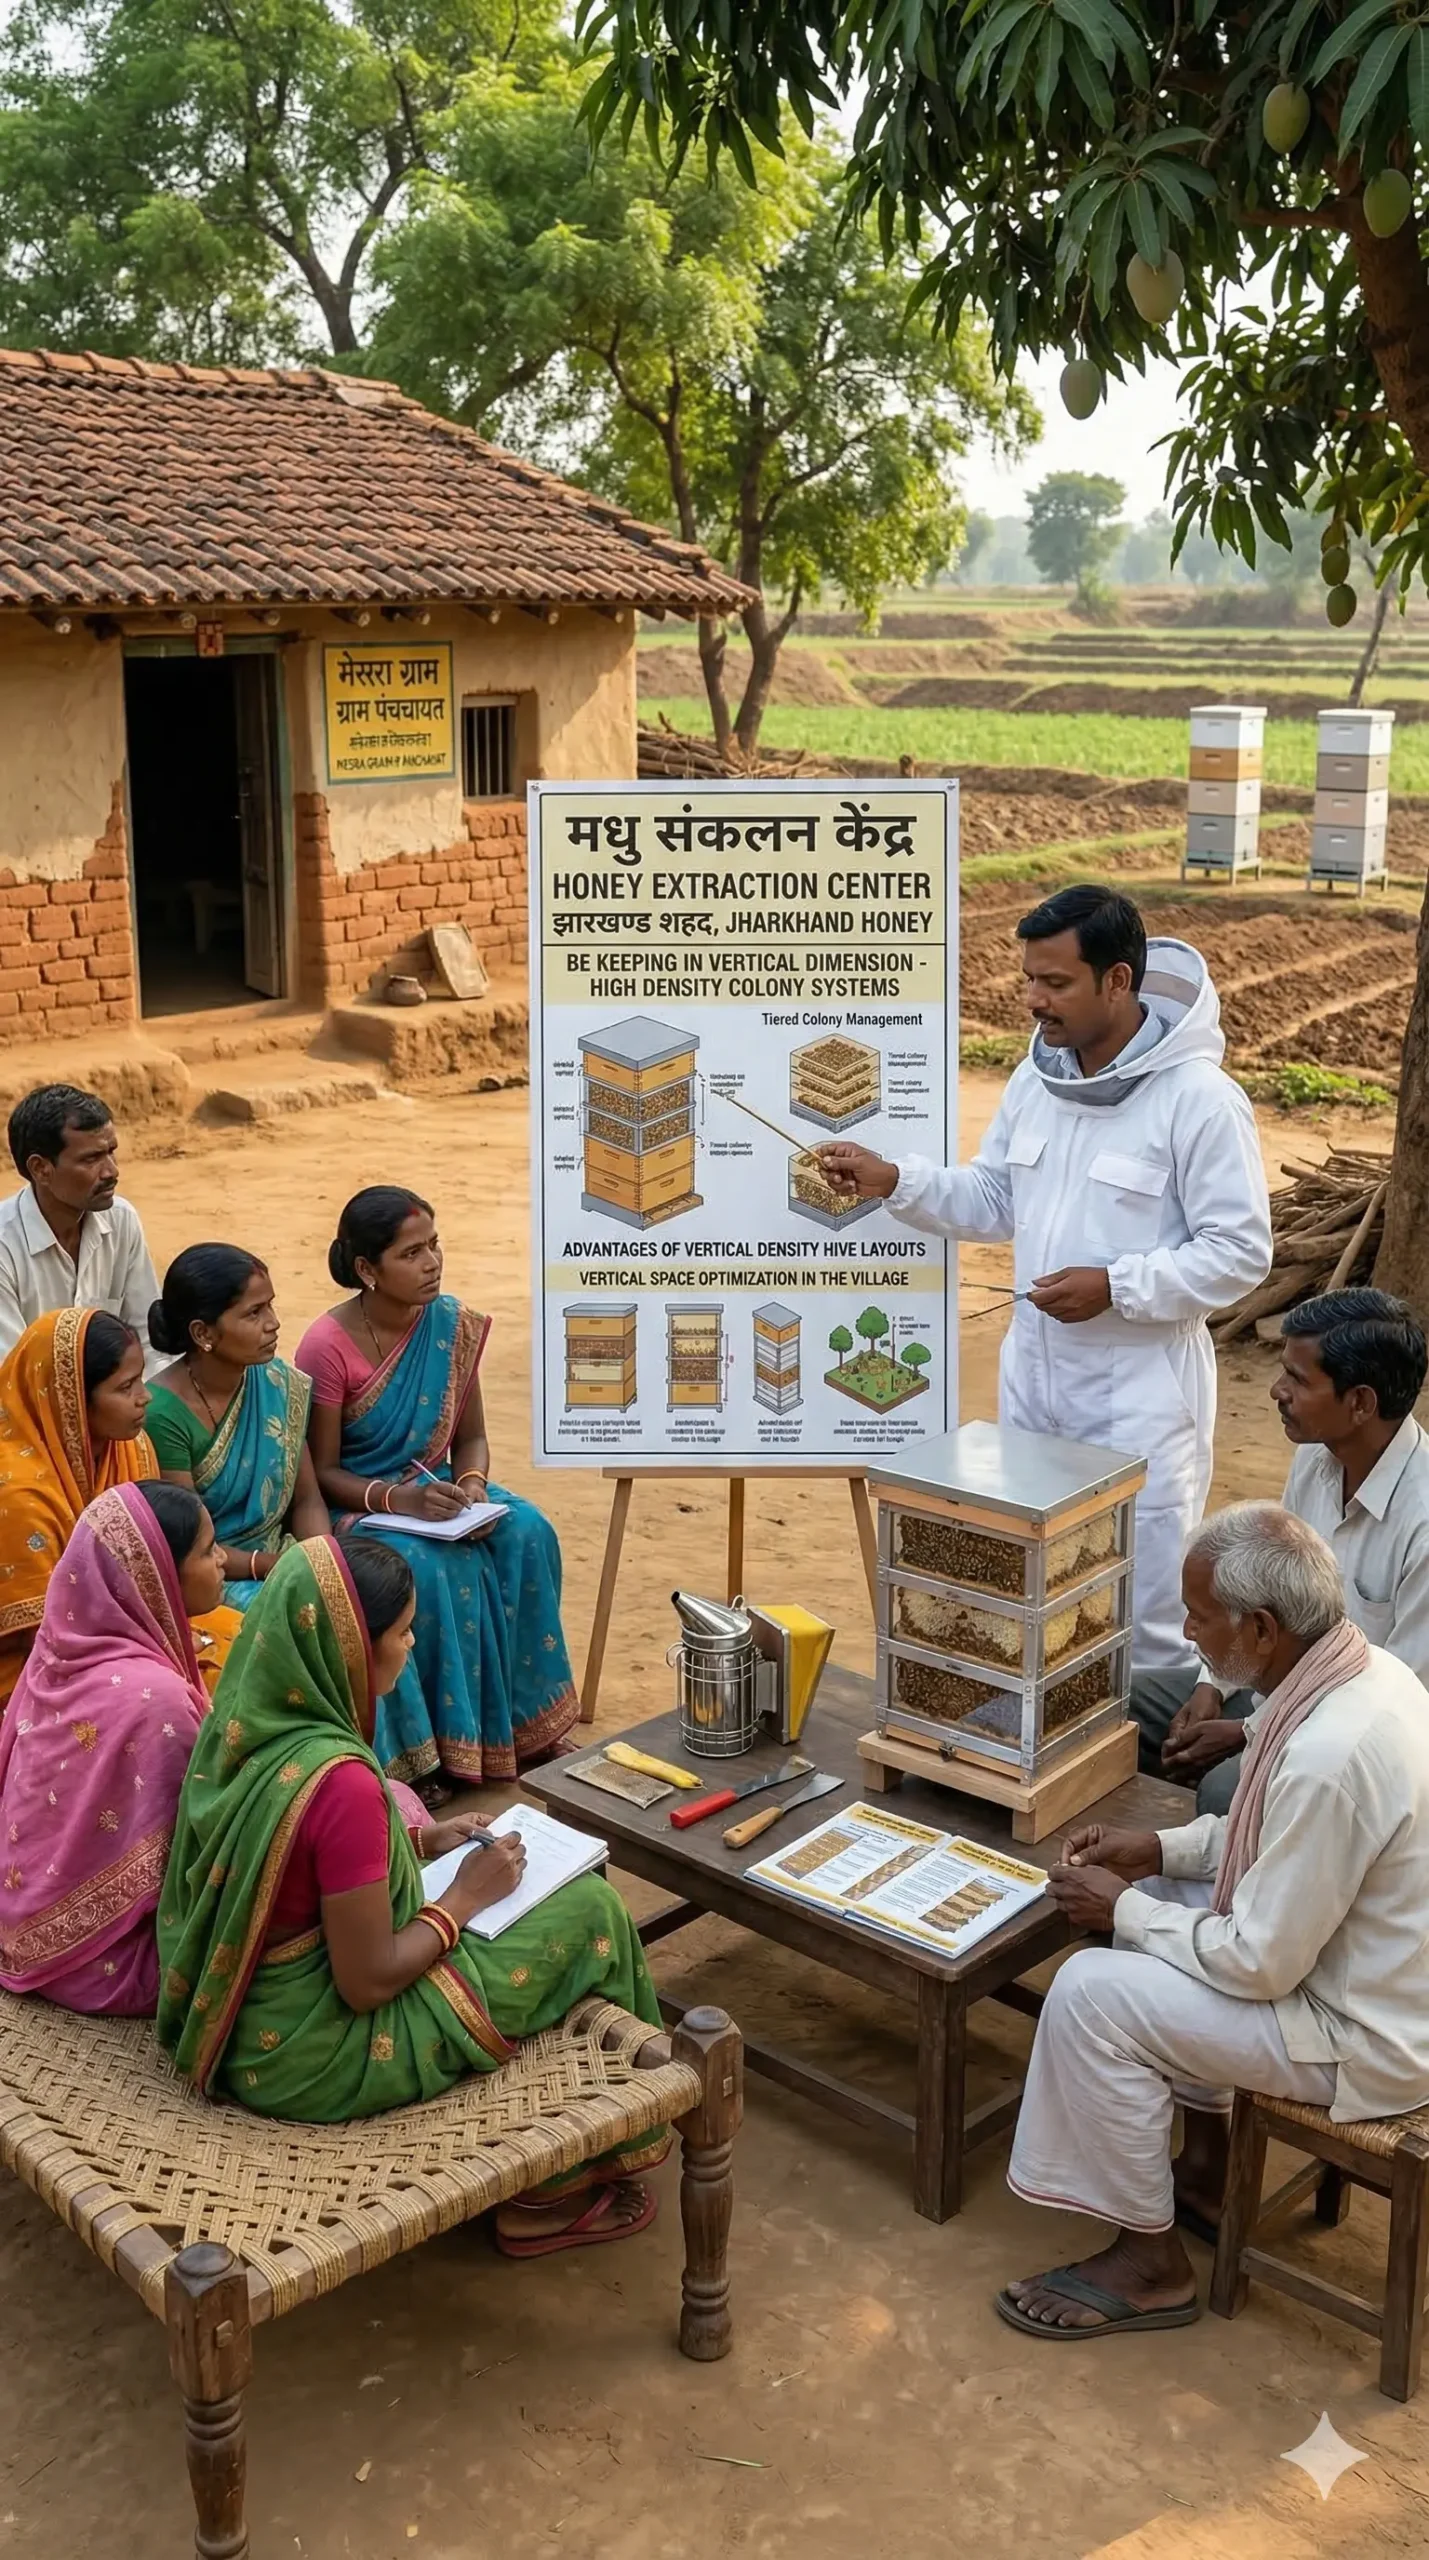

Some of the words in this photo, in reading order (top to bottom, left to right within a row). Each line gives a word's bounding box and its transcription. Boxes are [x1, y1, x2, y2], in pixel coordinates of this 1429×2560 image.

[399, 659, 439, 687] ग्राम
[336, 700, 371, 724] ग्राम
[565, 815, 641, 866] मधु
[653, 803, 820, 852] संकलन
[833, 801, 917, 857] केंद्र
[553, 872, 643, 899] HONEY
[652, 872, 817, 899] EXTRACTION
[827, 872, 931, 899] CENTER
[552, 912, 652, 937] झारखण्ड
[659, 912, 718, 937] शहद,
[725, 911, 854, 933] JHARKHAND
[861, 911, 933, 933] HONEY
[567, 953, 590, 972] BE
[597, 953, 677, 972] KEEPING
[683, 953, 703, 972] IN
[708, 953, 799, 972] VERTICAL
[805, 952, 913, 972] DIMENSION
[590, 977, 635, 997] HIGH
[643, 977, 722, 997] DENSITY
[728, 977, 804, 997] COLONY
[811, 977, 900, 997] SYSTEMS
[761, 1012, 798, 1026] Tiered
[802, 1011, 842, 1027] Colony
[846, 1012, 922, 1027] Management
[562, 1241, 657, 1257] ADVANTAGES
[661, 1241, 680, 1257] OF
[684, 1241, 753, 1257] VERTICAL
[757, 1241, 819, 1257] DENSITY
[823, 1241, 857, 1257] HIVE
[861, 1241, 926, 1257] LAYOUTS
[579, 1270, 646, 1286] VERTICAL
[650, 1270, 695, 1286] SPACE
[698, 1270, 797, 1286] OPTIMIZATION
[801, 1270, 815, 1286] IN
[819, 1270, 847, 1286] THE
[850, 1270, 909, 1286] VILLAGE
